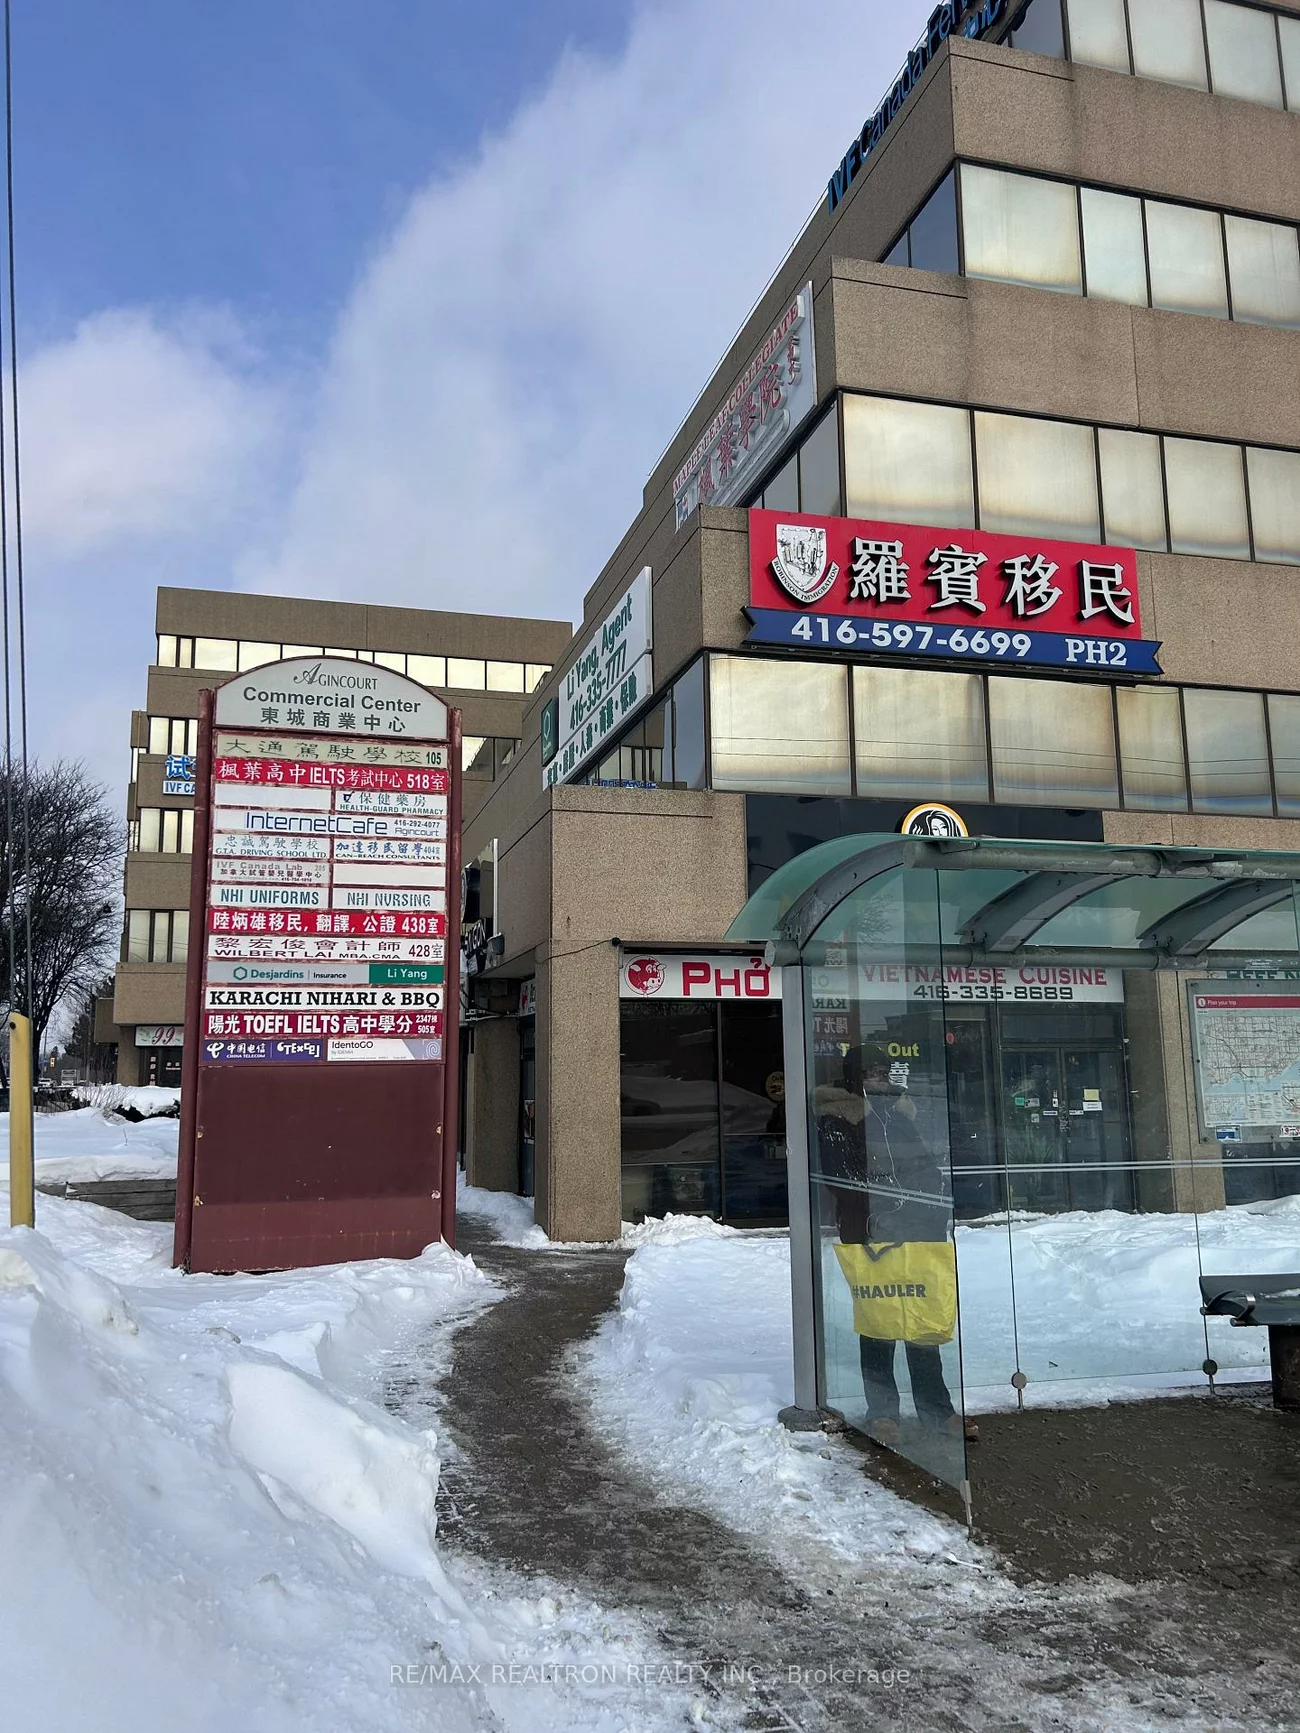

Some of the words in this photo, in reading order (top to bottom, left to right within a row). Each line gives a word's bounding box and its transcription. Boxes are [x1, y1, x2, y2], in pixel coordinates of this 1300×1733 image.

[828, 139, 861, 215] IVF
[859, 46, 925, 165] Canada
[672, 451, 703, 495] MAPLE
[702, 409, 729, 453] LEAF
[727, 302, 799, 413] COLLEGIATE
[773, 560, 799, 597] ROBINSON
[800, 566, 838, 601] IMMIGRATION
[850, 536, 1135, 623] 羅賓移民
[567, 672, 575, 701] Li
[575, 644, 600, 688] Yang,
[601, 592, 633, 657] Agent
[791, 616, 1032, 657] 416-597-6699
[1065, 638, 1128, 666] PH2
[569, 638, 628, 731] 416-335-7777
[243, 686, 355, 709] Commercial
[361, 695, 421, 713] Center
[260, 706, 406, 733] 東城商業中心
[223, 738, 422, 764] 大通駕駛學校
[426, 751, 442, 765] 105
[165, 782, 182, 793] IVF
[359, 791, 427, 808] 保健藥房
[340, 803, 399, 813] HEALTH-GUARD
[402, 806, 444, 815] PHARMACY
[394, 819, 441, 829] 416-292-4077
[394, 827, 439, 837] Agincourt
[225, 835, 318, 851] 忠誠駕駛學校
[240, 848, 274, 857] DRIVING
[276, 850, 308, 858] SCHOOL
[312, 851, 328, 859] LTD.
[216, 861, 235, 869] IVF
[240, 862, 281, 870] Canada
[285, 863, 303, 871] Lab
[220, 888, 244, 902] NHI
[250, 889, 319, 905] UNIFORMS
[347, 892, 369, 906] NHI
[375, 893, 431, 907] NURSING
[362, 915, 396, 933] 公證
[215, 937, 402, 952] 黎宏俊會計師
[215, 949, 298, 957] WILBERT
[251, 969, 304, 980] Desjardins
[387, 968, 397, 978] Li
[400, 968, 427, 980] Yang
[863, 966, 1006, 985] VIETNAMESE
[1019, 967, 1107, 986] CUISINE
[210, 991, 302, 1006] KARACHI
[306, 991, 377, 1006] NIHARI
[381, 991, 396, 1006] &
[400, 992, 440, 1008] BBQ
[913, 984, 1074, 1000] 416-335-8689
[208, 1014, 240, 1034] 陽光
[243, 1014, 293, 1034] TOEFL
[297, 1015, 340, 1034] IELTS
[342, 1014, 413, 1034] 高中學分
[331, 1041, 374, 1049] IdentoGO
[887, 1042, 920, 1057] Out
[852, 1283, 927, 1299] #HAULER
